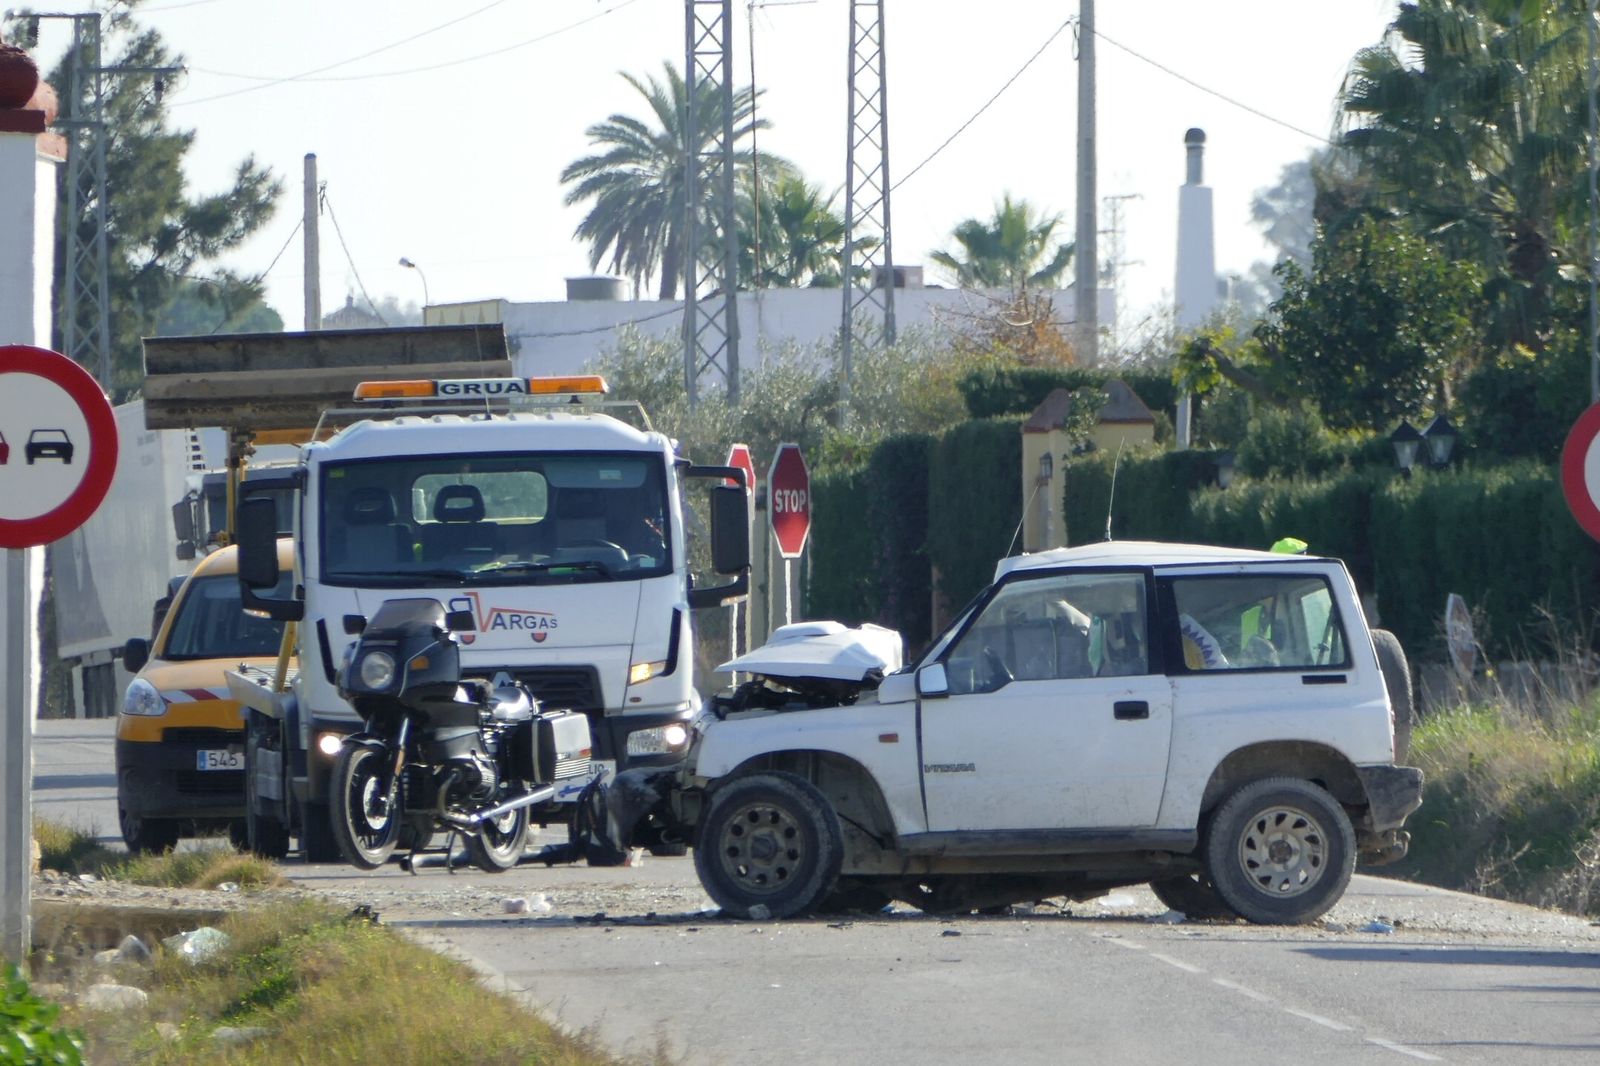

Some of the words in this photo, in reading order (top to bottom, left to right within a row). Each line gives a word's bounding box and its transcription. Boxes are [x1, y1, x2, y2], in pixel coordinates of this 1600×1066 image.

[439, 383, 524, 395] GRUA
[774, 489, 807, 513] STOP
[463, 591, 558, 632] VARGAS
